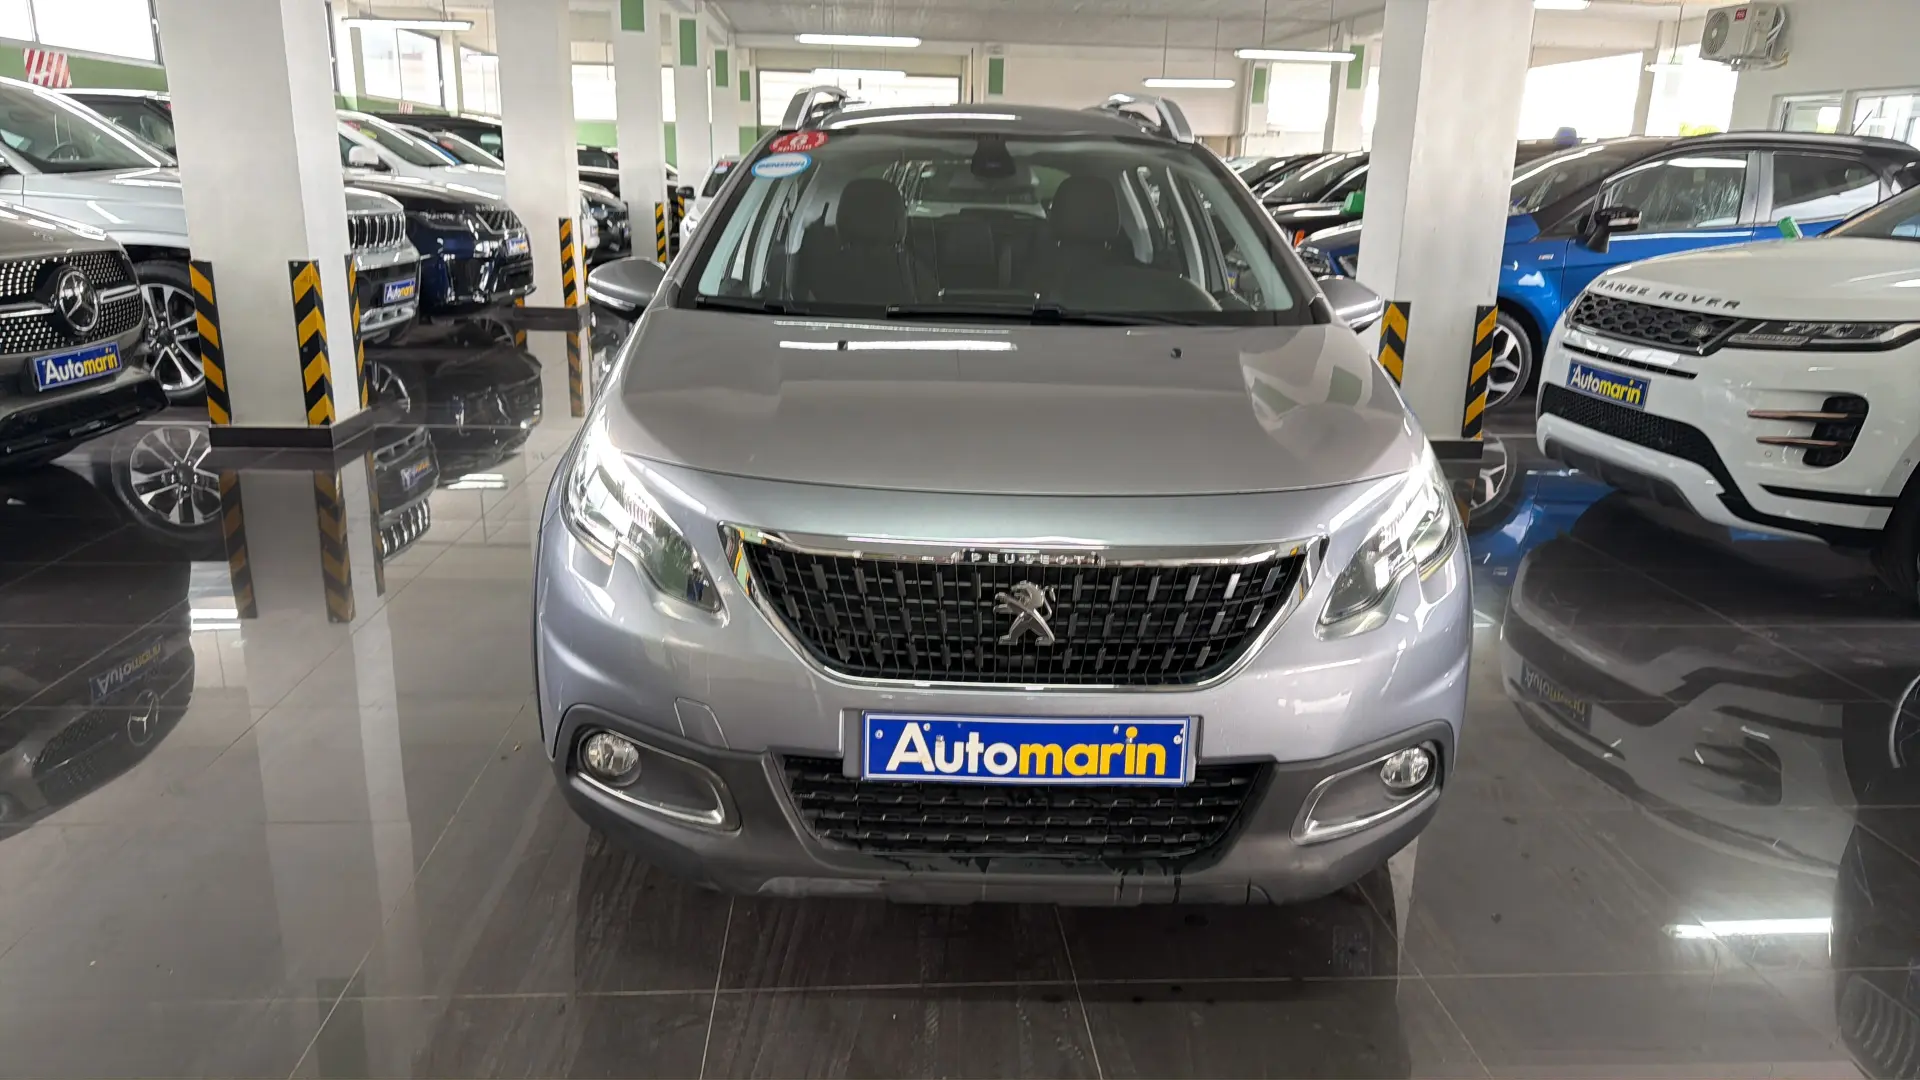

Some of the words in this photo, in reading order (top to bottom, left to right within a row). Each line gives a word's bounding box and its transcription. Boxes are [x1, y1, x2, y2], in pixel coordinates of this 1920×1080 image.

[1597, 279, 1650, 296] RANGE
[1658, 290, 1741, 309] ROVER
[46, 347, 118, 385] Automarin
[1571, 365, 1642, 405] Automarin
[970, 551, 1087, 565] PEUGEOT
[885, 721, 1167, 776] Automarin
